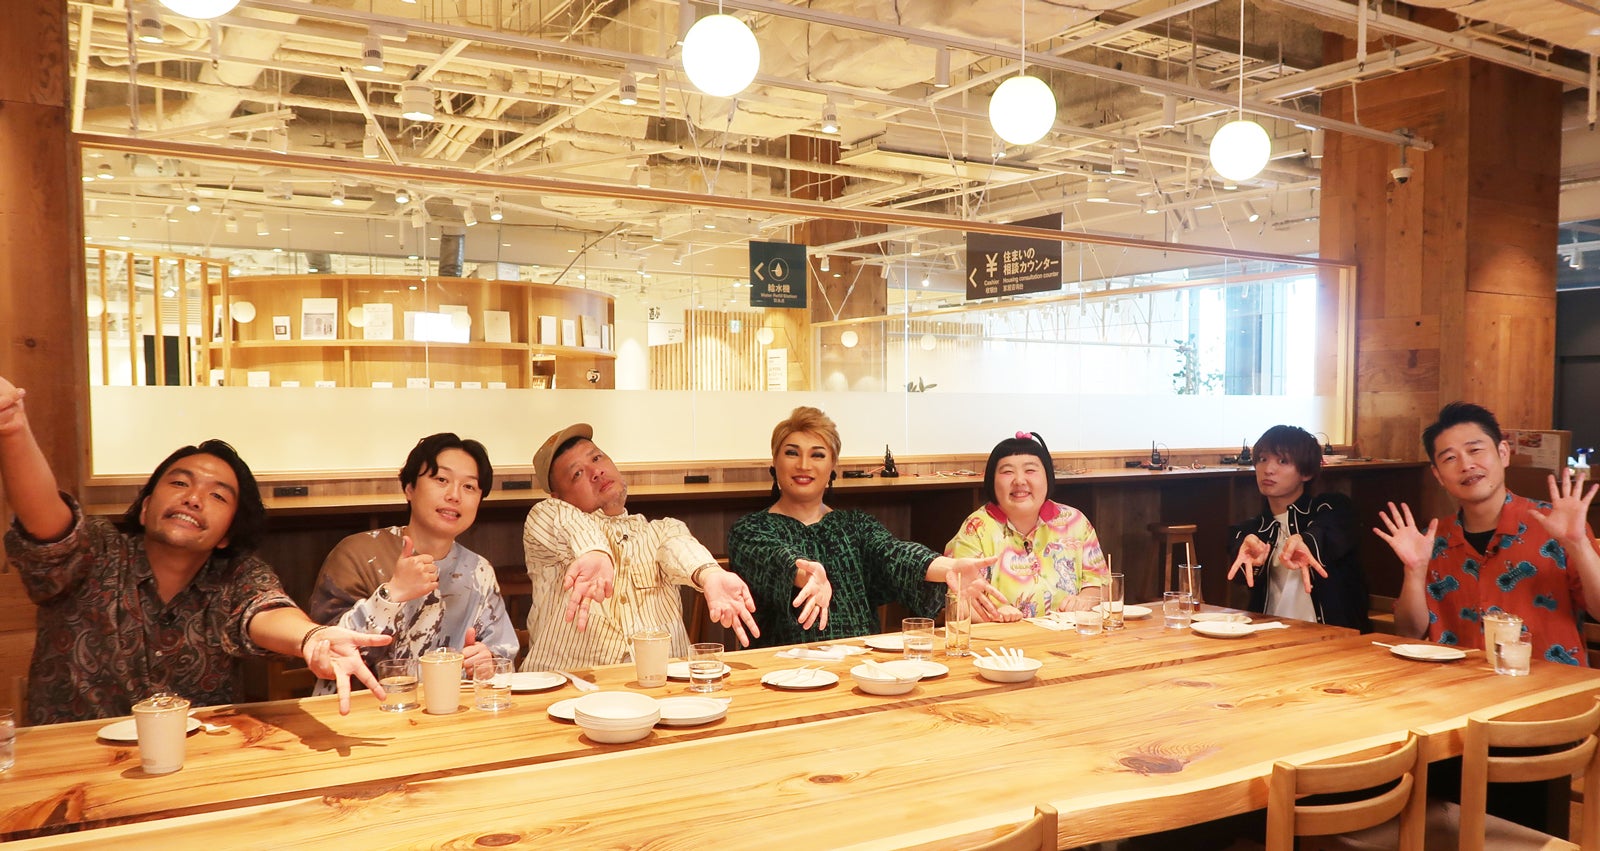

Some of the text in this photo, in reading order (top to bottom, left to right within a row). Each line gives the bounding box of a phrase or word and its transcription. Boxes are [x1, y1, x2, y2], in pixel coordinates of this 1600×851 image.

[1003, 247, 1035, 263] 住まいの
[1003, 257, 1059, 276] 相談カウンター
[983, 279, 999, 287] Cashier
[1003, 271, 1059, 284] Housing consultation counter
